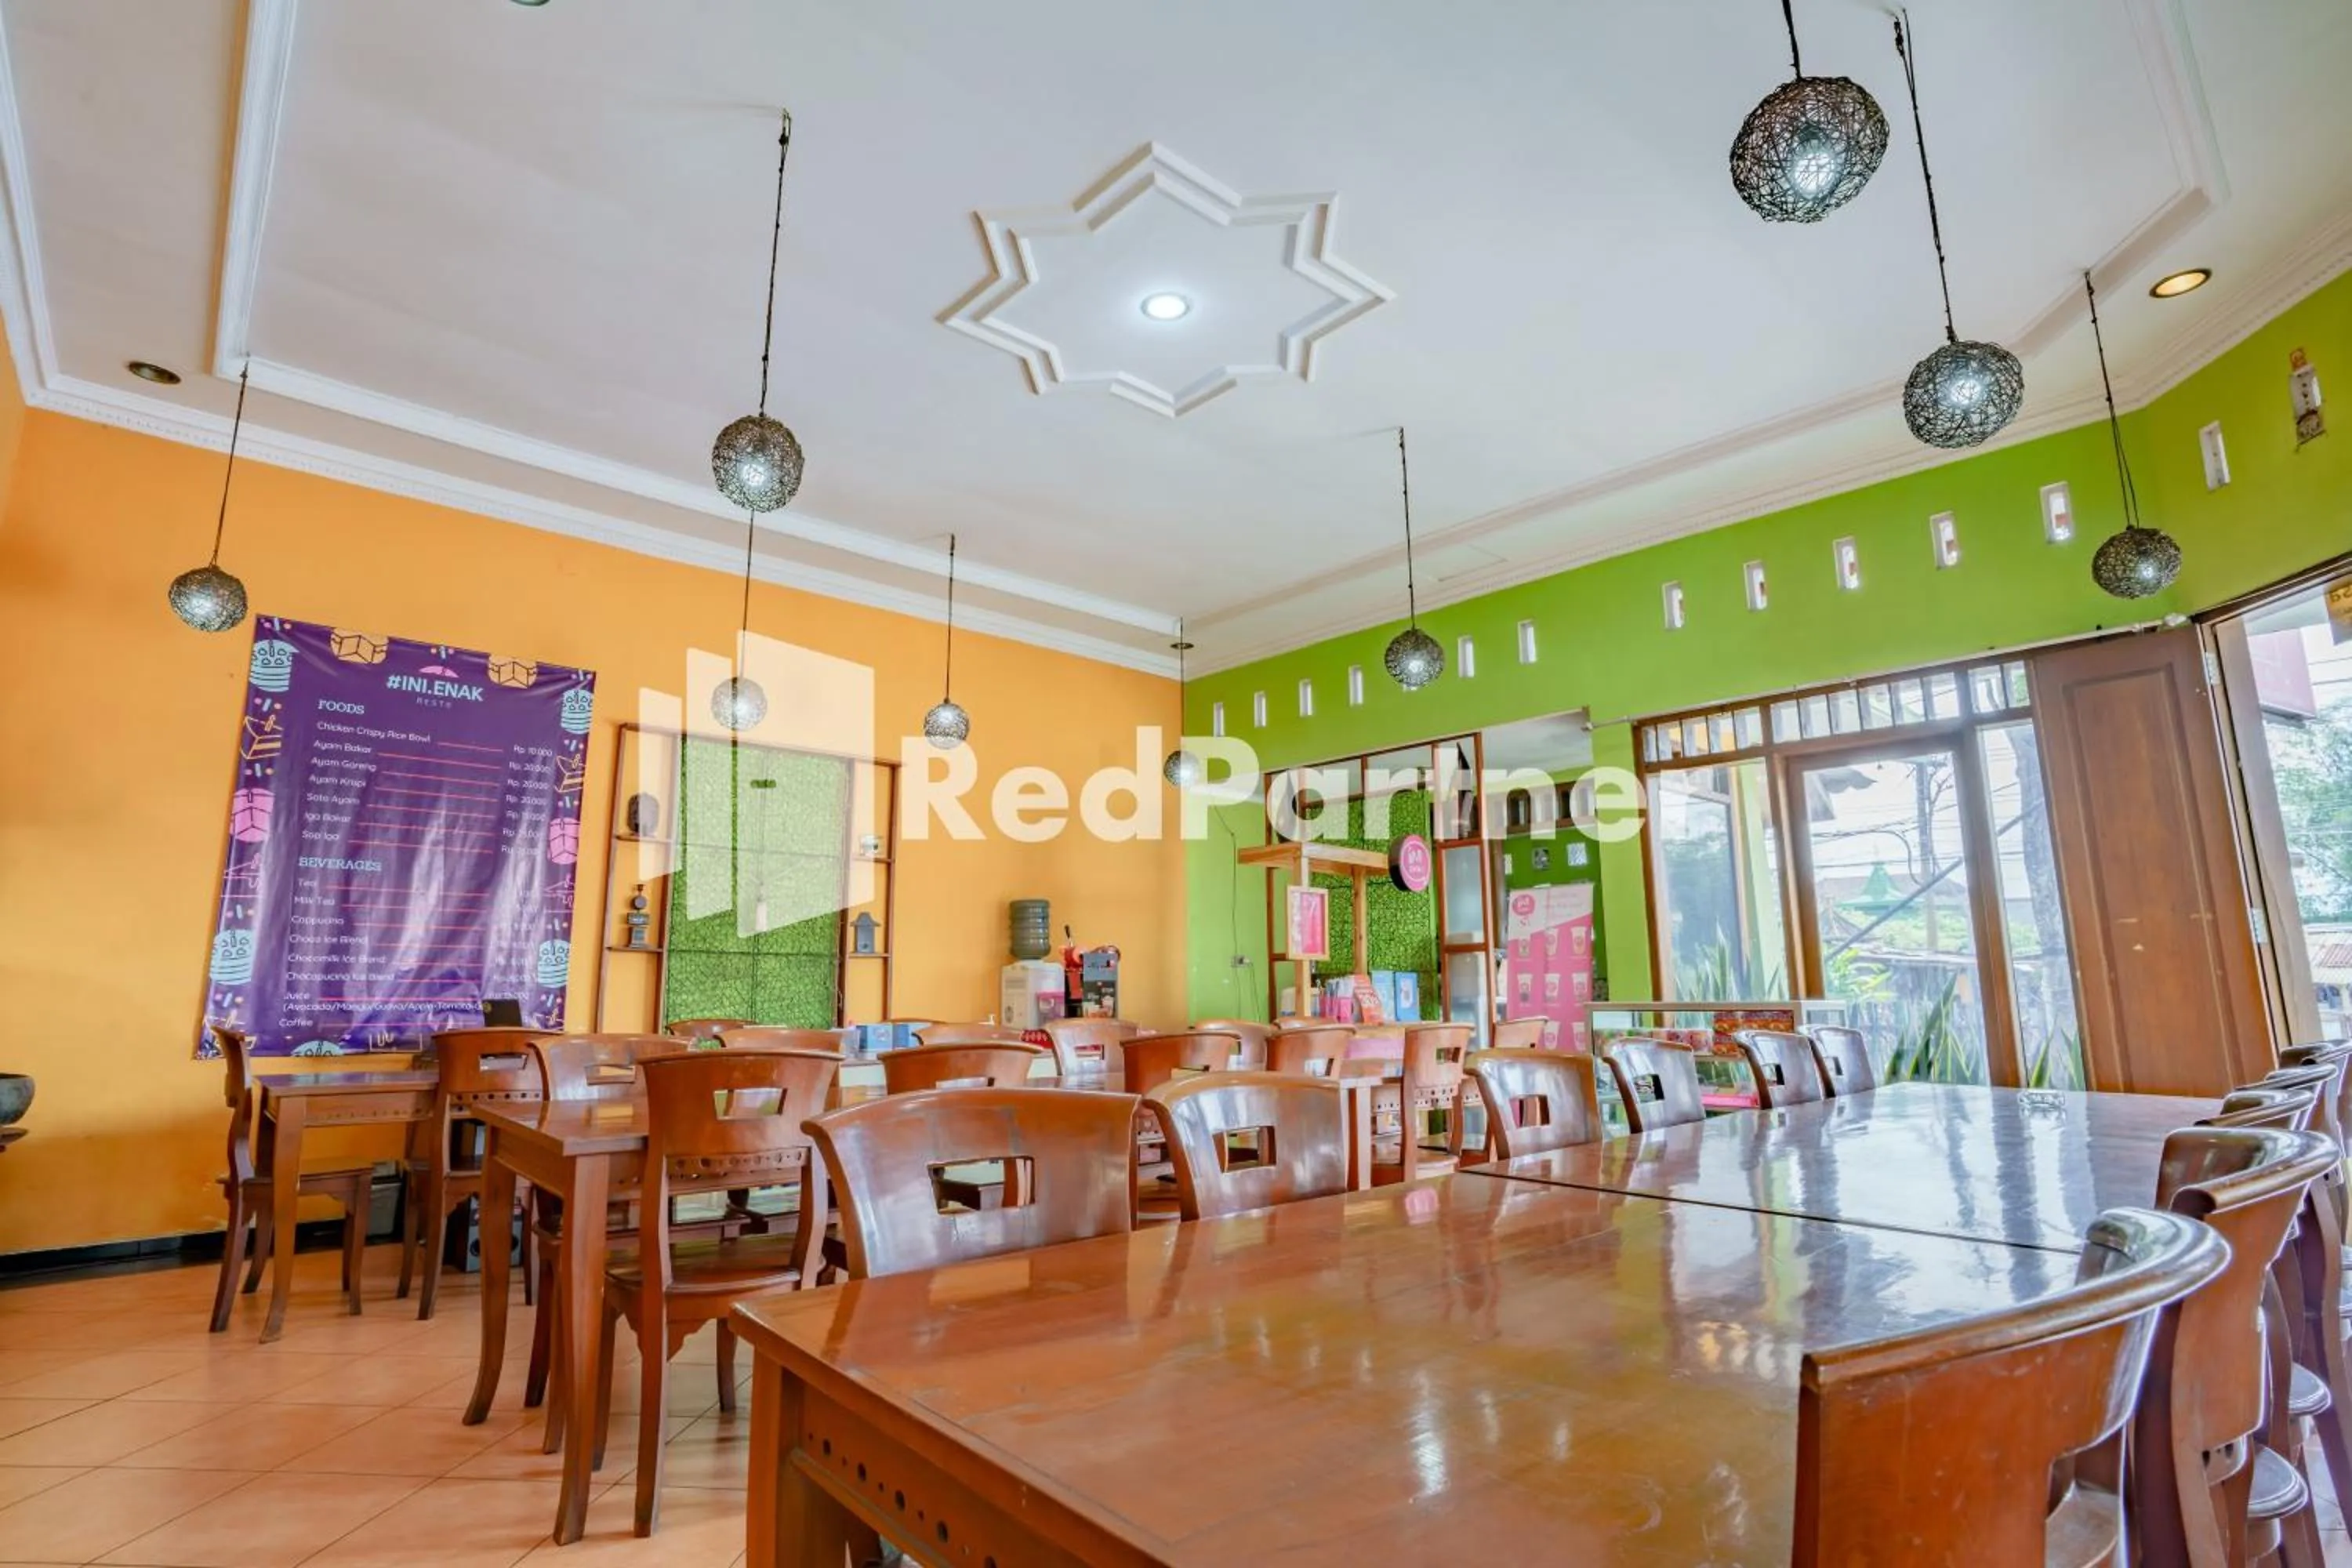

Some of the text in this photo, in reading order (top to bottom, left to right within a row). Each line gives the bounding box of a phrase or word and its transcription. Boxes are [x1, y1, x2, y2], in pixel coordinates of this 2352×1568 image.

[387, 674, 484, 702] #INI.ENAK
[318, 699, 365, 714] FOODS
[317, 720, 354, 732] Chicken
[356, 726, 384, 739] Crispy
[408, 732, 430, 742] Bowl
[314, 739, 372, 753] Ayam Bakar
[310, 757, 339, 767] Ayam
[309, 774, 338, 785] Ayam
[331, 795, 360, 805] Ayam
[299, 857, 382, 871] BEVERAGES
[278, 1018, 314, 1027] Coffee
